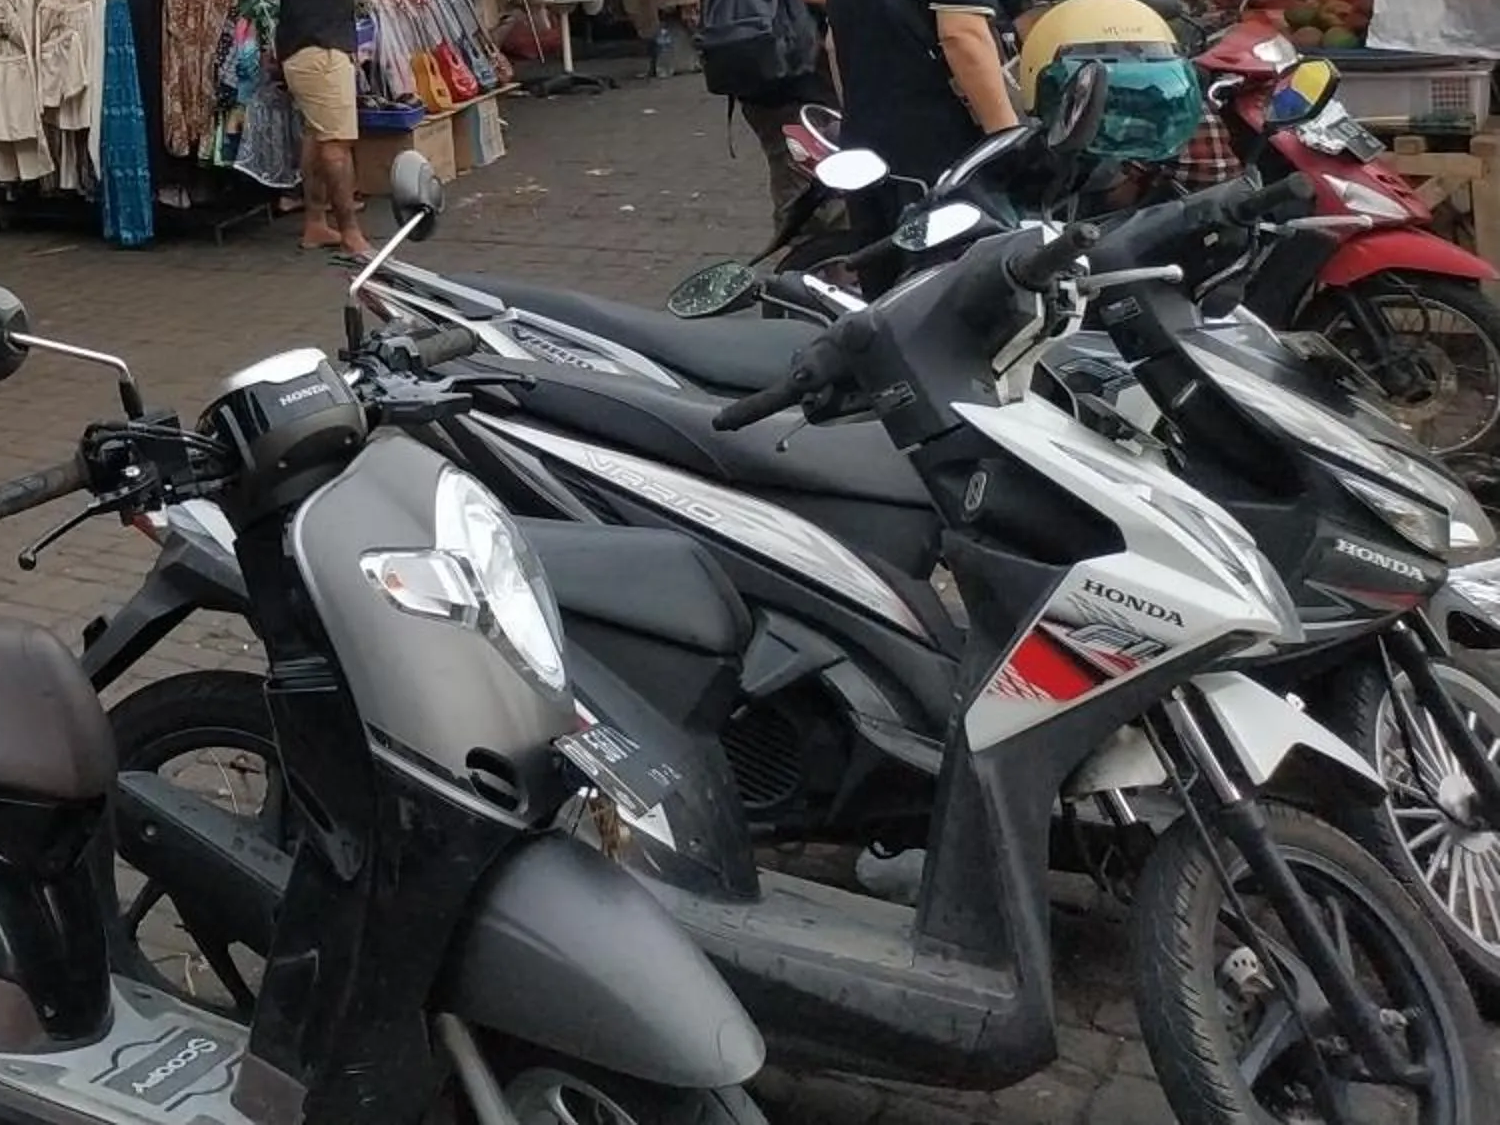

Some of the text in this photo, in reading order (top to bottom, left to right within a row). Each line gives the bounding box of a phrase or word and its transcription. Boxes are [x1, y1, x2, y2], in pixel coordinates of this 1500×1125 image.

[279, 383, 331, 406] HONDA
[1335, 538, 1426, 583] HONDA
[1082, 578, 1185, 628] HONDA
